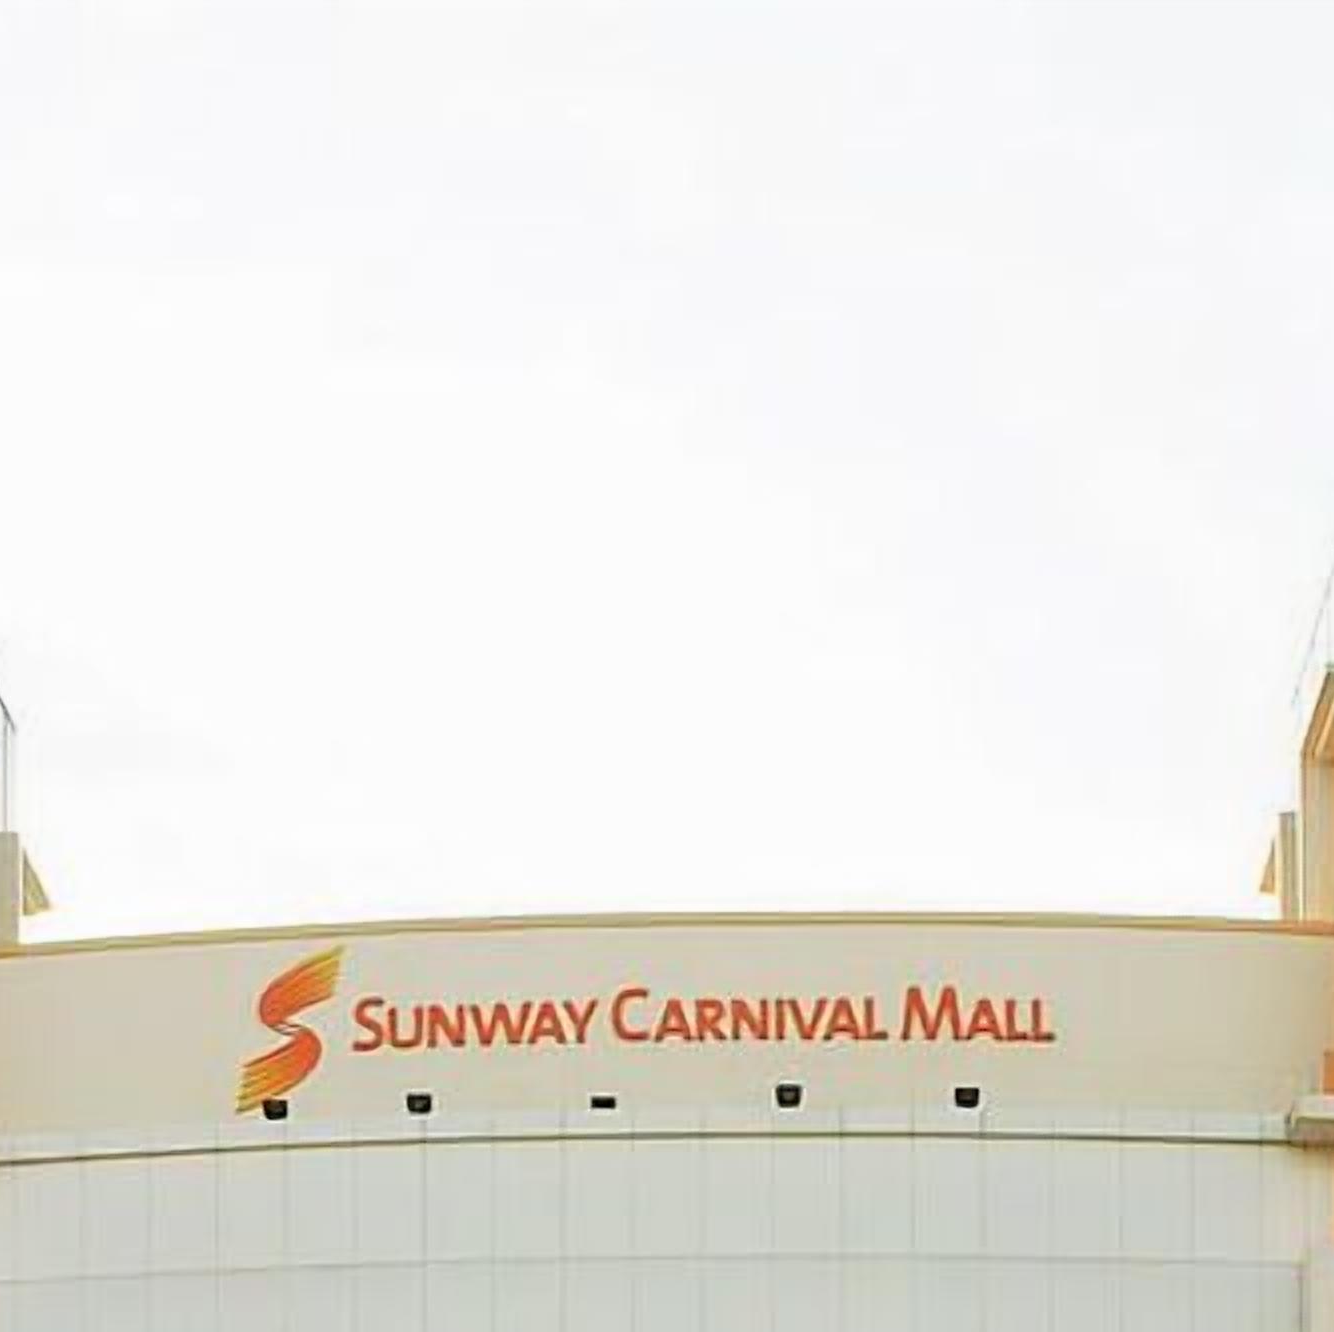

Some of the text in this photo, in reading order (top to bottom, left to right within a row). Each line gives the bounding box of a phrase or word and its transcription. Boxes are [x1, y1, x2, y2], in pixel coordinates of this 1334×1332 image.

[351, 985, 1056, 1052] SUNWAY CARNIVAL MALL
